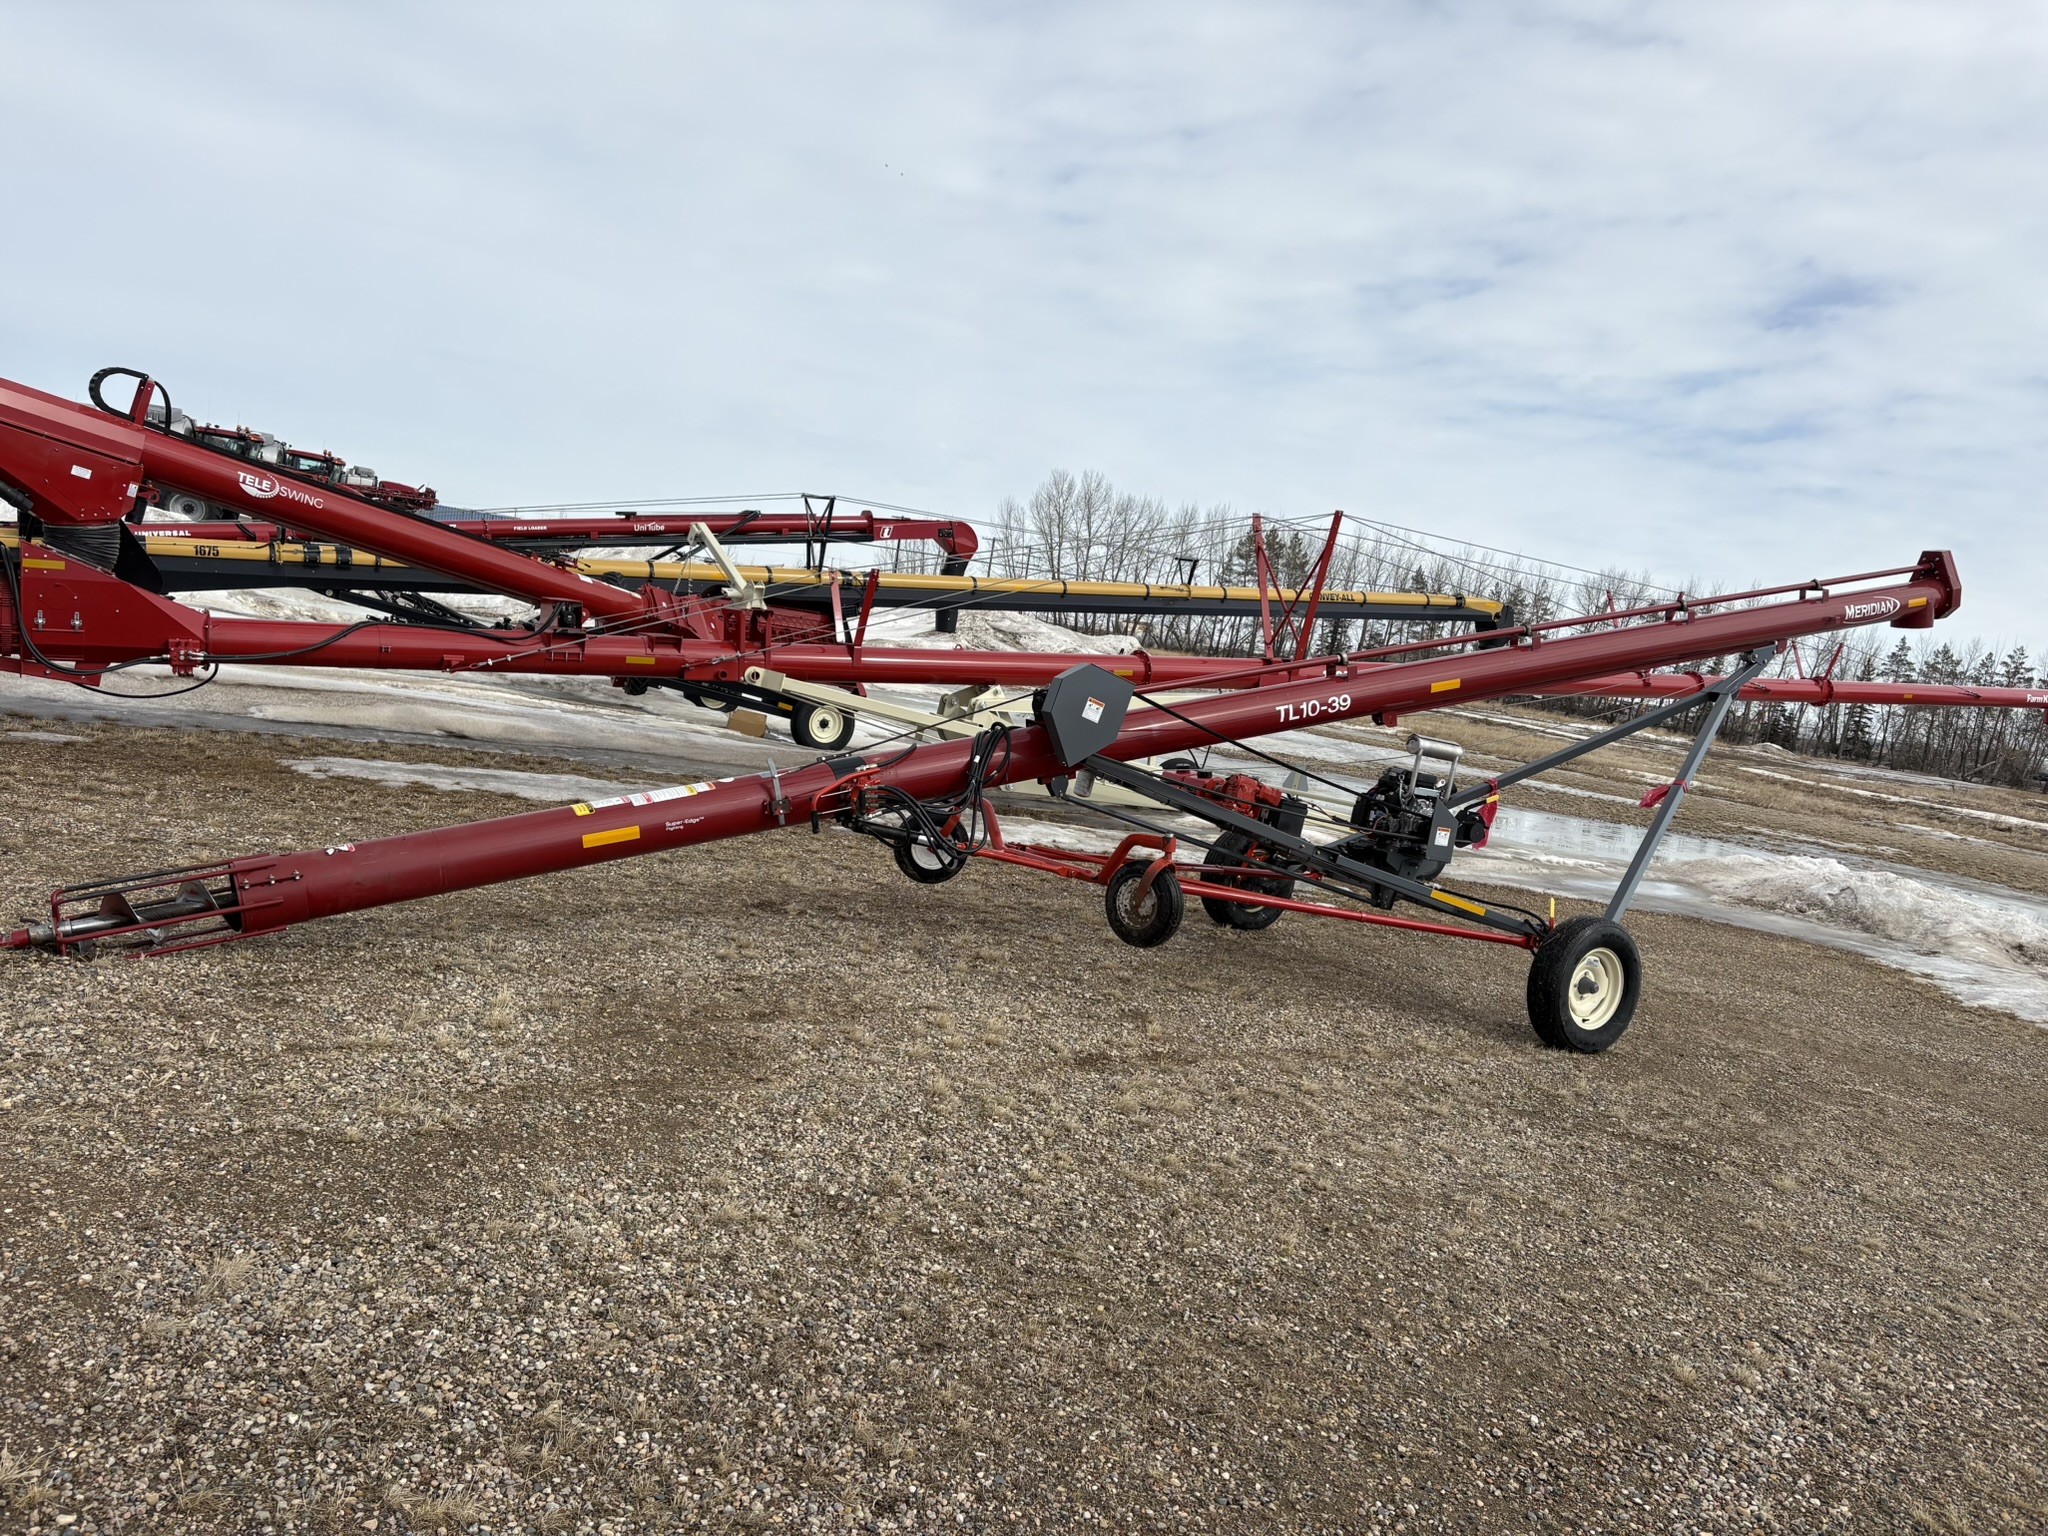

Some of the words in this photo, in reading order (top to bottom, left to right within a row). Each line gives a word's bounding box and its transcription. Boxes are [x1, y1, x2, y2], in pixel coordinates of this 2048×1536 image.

[237, 471, 272, 491] TELE
[279, 486, 324, 509] SWING
[633, 521, 665, 532] UniTube
[193, 545, 219, 557] 1675
[1844, 600, 1895, 620] MERIDIAN
[1275, 694, 1351, 723] TL10-39
